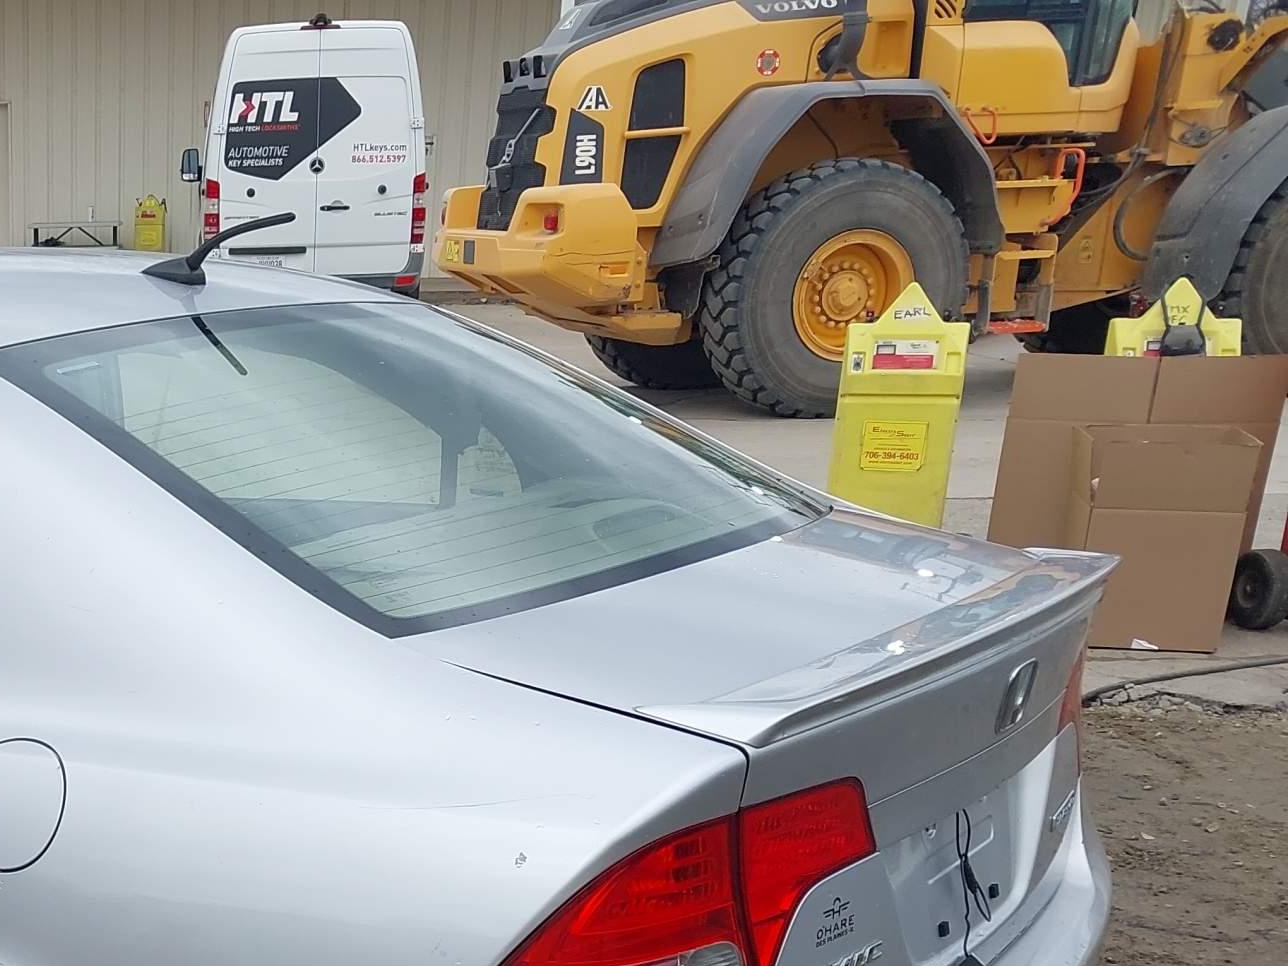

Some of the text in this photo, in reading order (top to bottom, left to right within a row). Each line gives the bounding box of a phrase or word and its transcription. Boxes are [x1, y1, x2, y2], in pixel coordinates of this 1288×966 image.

[755, 0, 838, 13] VOLVO
[229, 91, 299, 124] HTL
[228, 125, 244, 133] HIGH
[228, 145, 290, 158] AUTOMOTIVE
[353, 144, 408, 153] HTLkeys.com
[352, 155, 407, 163] 866.512.5397
[574, 134, 597, 175] L90H
[228, 158, 284, 167] KEY SPECIALISTS
[893, 307, 932, 320] EARL
[864, 451, 919, 461] 706-394-6403
[815, 938, 827, 949] DES
